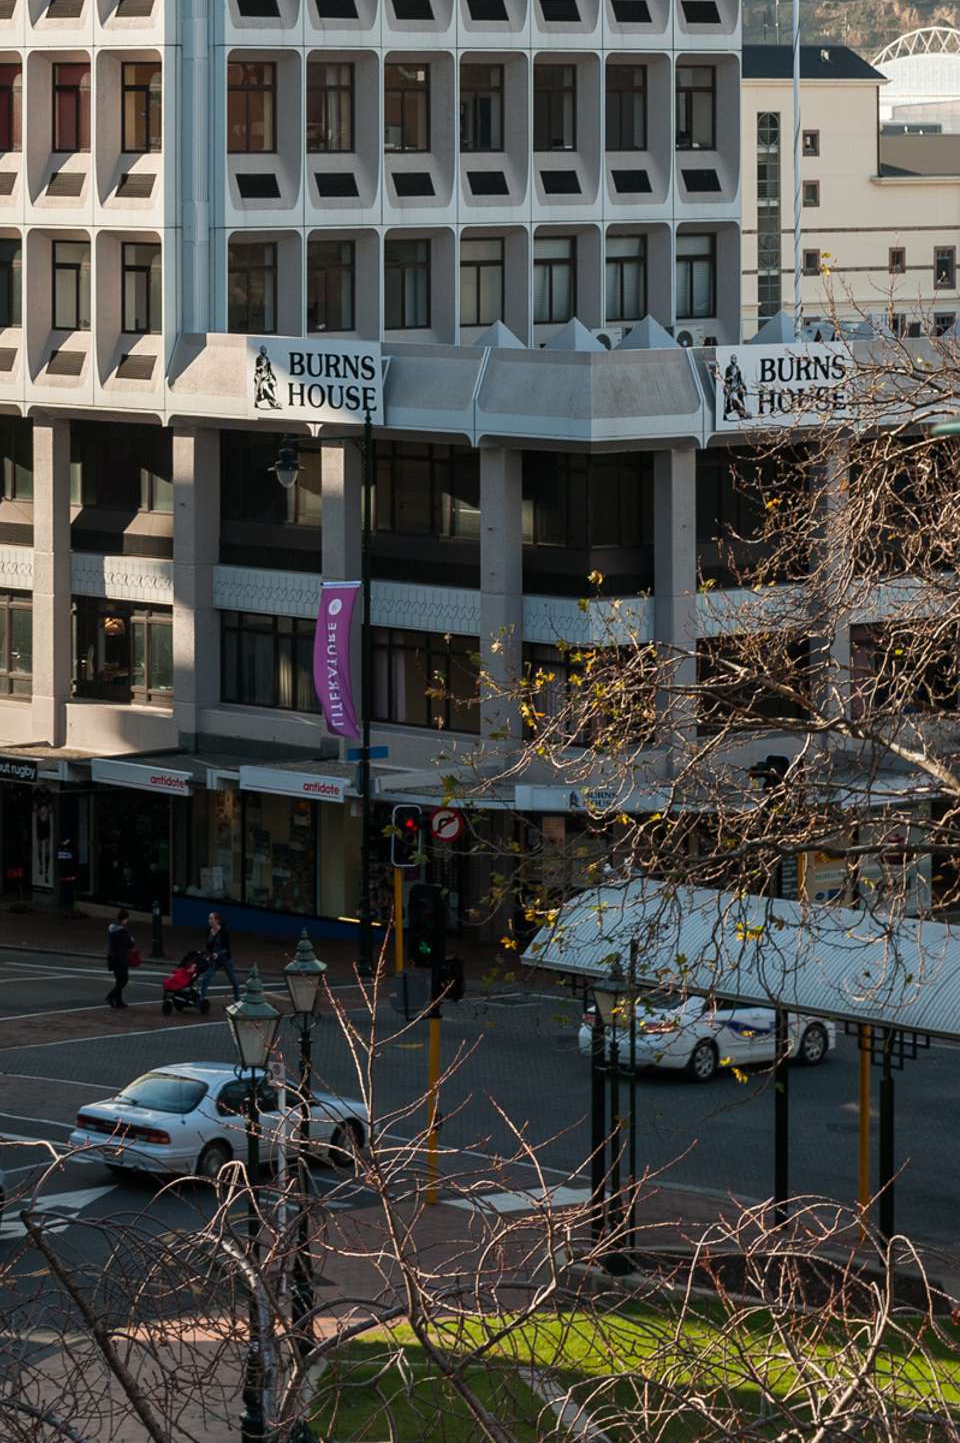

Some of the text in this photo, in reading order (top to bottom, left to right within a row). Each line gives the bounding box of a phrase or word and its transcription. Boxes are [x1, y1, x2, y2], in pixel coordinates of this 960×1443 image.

[288, 351, 376, 381] BURNS
[759, 355, 847, 383] BURNS
[287, 382, 377, 412] HOUSE
[11, 764, 36, 779] rugby
[150, 774, 185, 789] antidote
[303, 781, 340, 796] antidote
